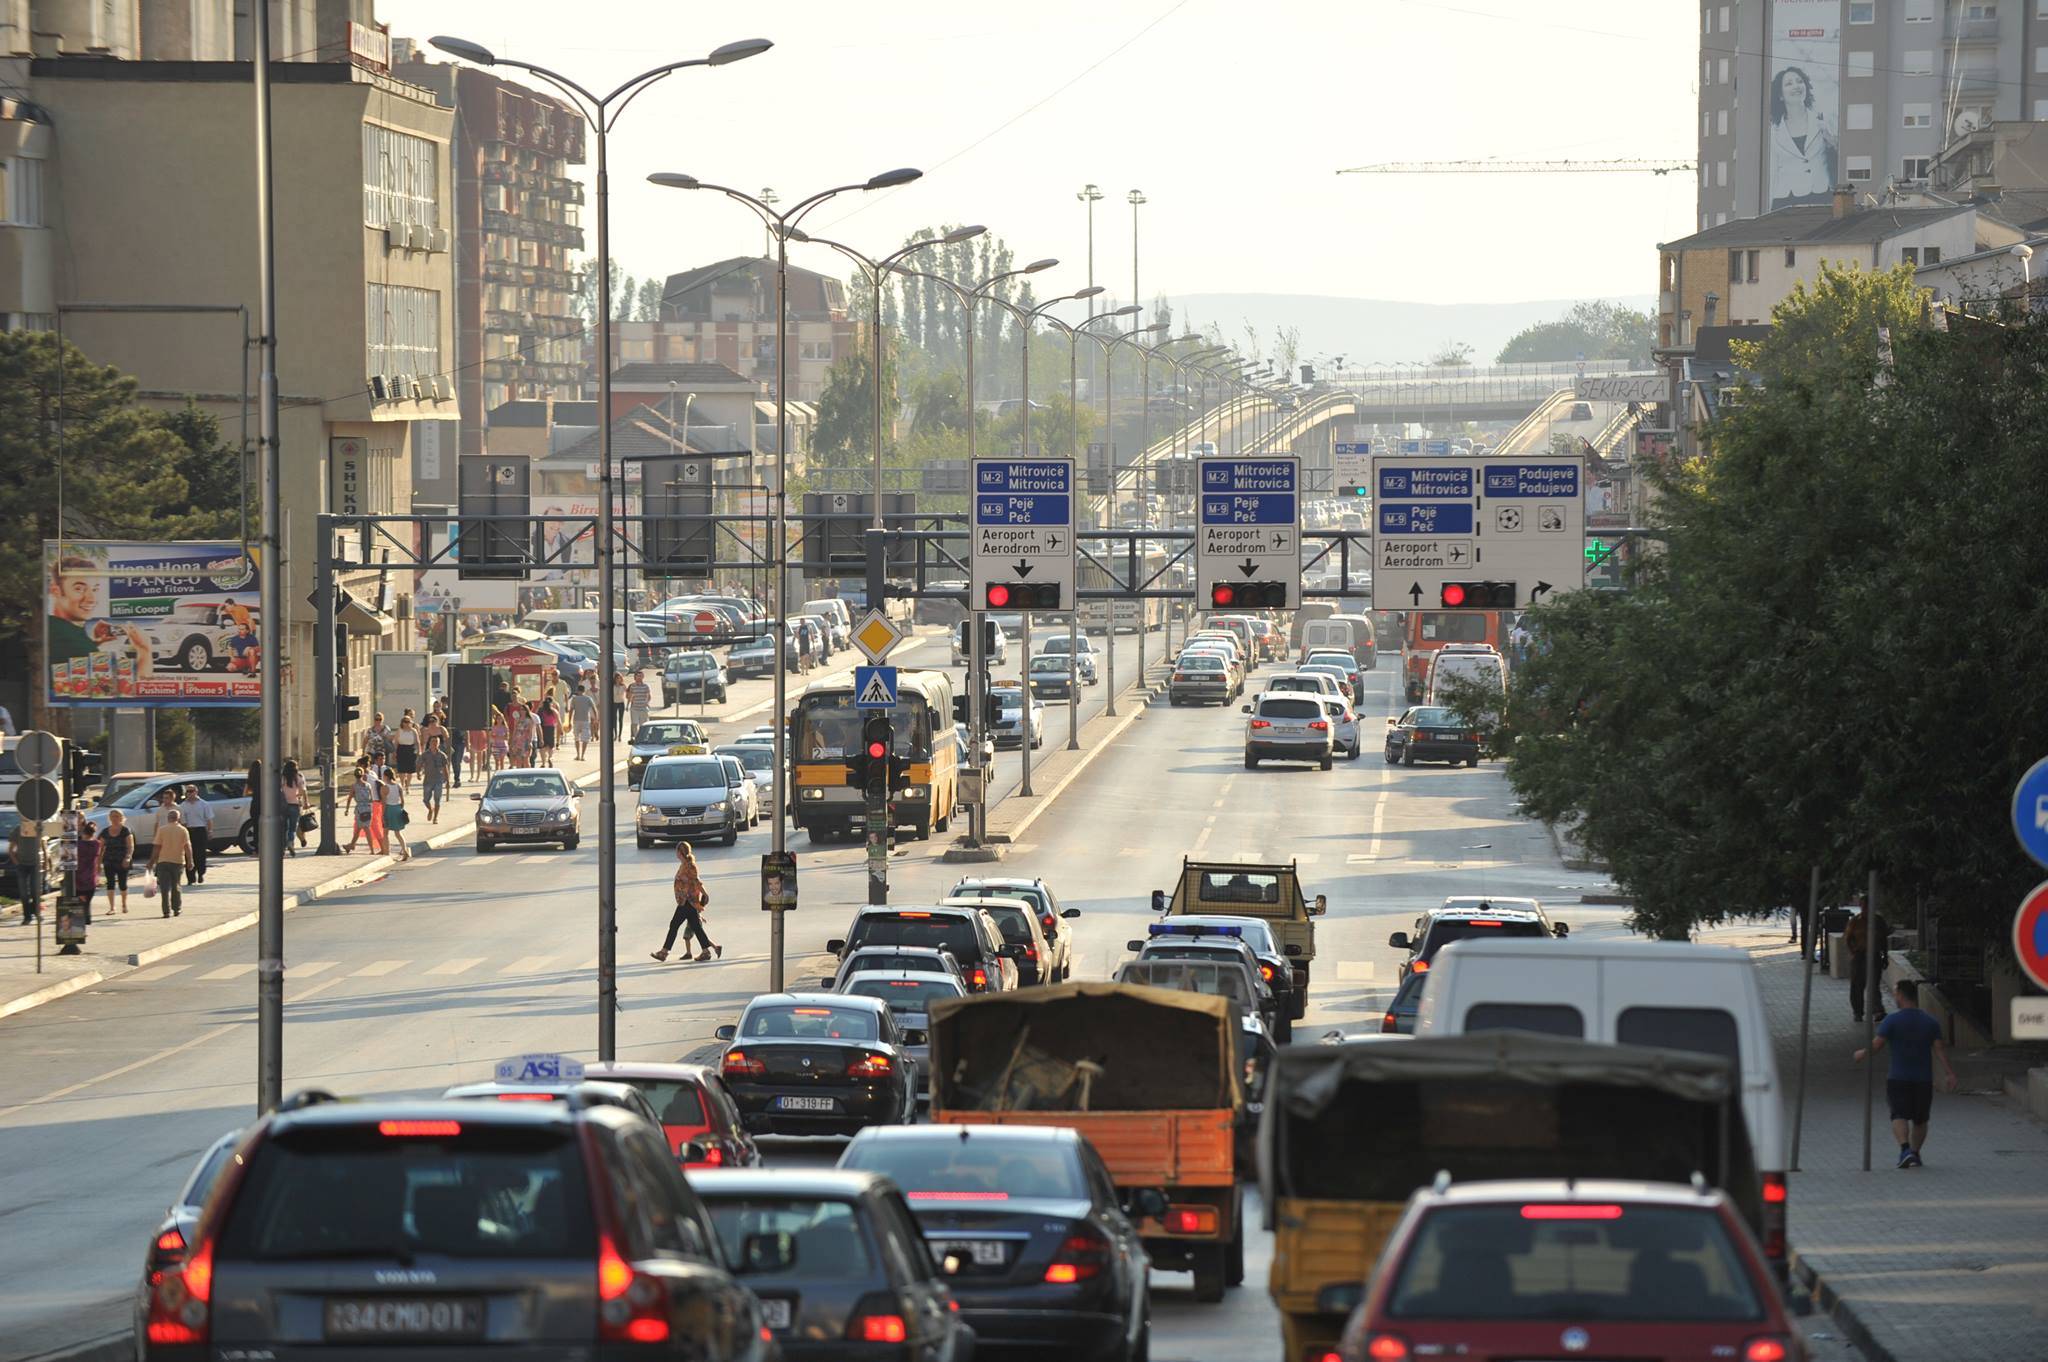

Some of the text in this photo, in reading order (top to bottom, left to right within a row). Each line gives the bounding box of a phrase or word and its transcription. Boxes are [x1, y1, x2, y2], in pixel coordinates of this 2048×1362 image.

[1009, 465, 1065, 477] Mitrovicë
[1234, 464, 1290, 476] Mitrovicë
[1411, 470, 1468, 482] Mitrovicë
[1519, 468, 1574, 481] Podujevë
[983, 473, 1001, 482] M-2
[1208, 472, 1226, 481] M-2
[1386, 478, 1405, 487] M-2
[1491, 477, 1514, 486] M-25
[1009, 478, 1065, 490] Mitrovica
[1234, 477, 1290, 489] Mitrovica
[1411, 483, 1468, 495] Mitrovica
[1519, 482, 1574, 496] Podujevo
[983, 505, 1001, 514] M-9
[1009, 497, 1034, 512] Pejë
[1208, 504, 1227, 513] M-9
[1234, 496, 1259, 511] Pejë
[1009, 511, 1031, 523] Peč
[1234, 510, 1257, 522] Peč
[1386, 514, 1405, 524] M-9
[1411, 506, 1437, 520] Pejë
[1411, 520, 1434, 532] Peč
[982, 529, 1035, 542] Aeroport
[1207, 528, 1261, 541] Aeroport
[982, 542, 1041, 554] Aerodrom
[1207, 542, 1266, 553] Aerodrom
[1384, 541, 1438, 555] Aeroport
[1384, 555, 1443, 566] Aerodrom
[112, 606, 134, 615] Mini
[135, 604, 170, 614] Cooper
[139, 687, 177, 695] Pushime
[185, 687, 216, 695] iPhone
